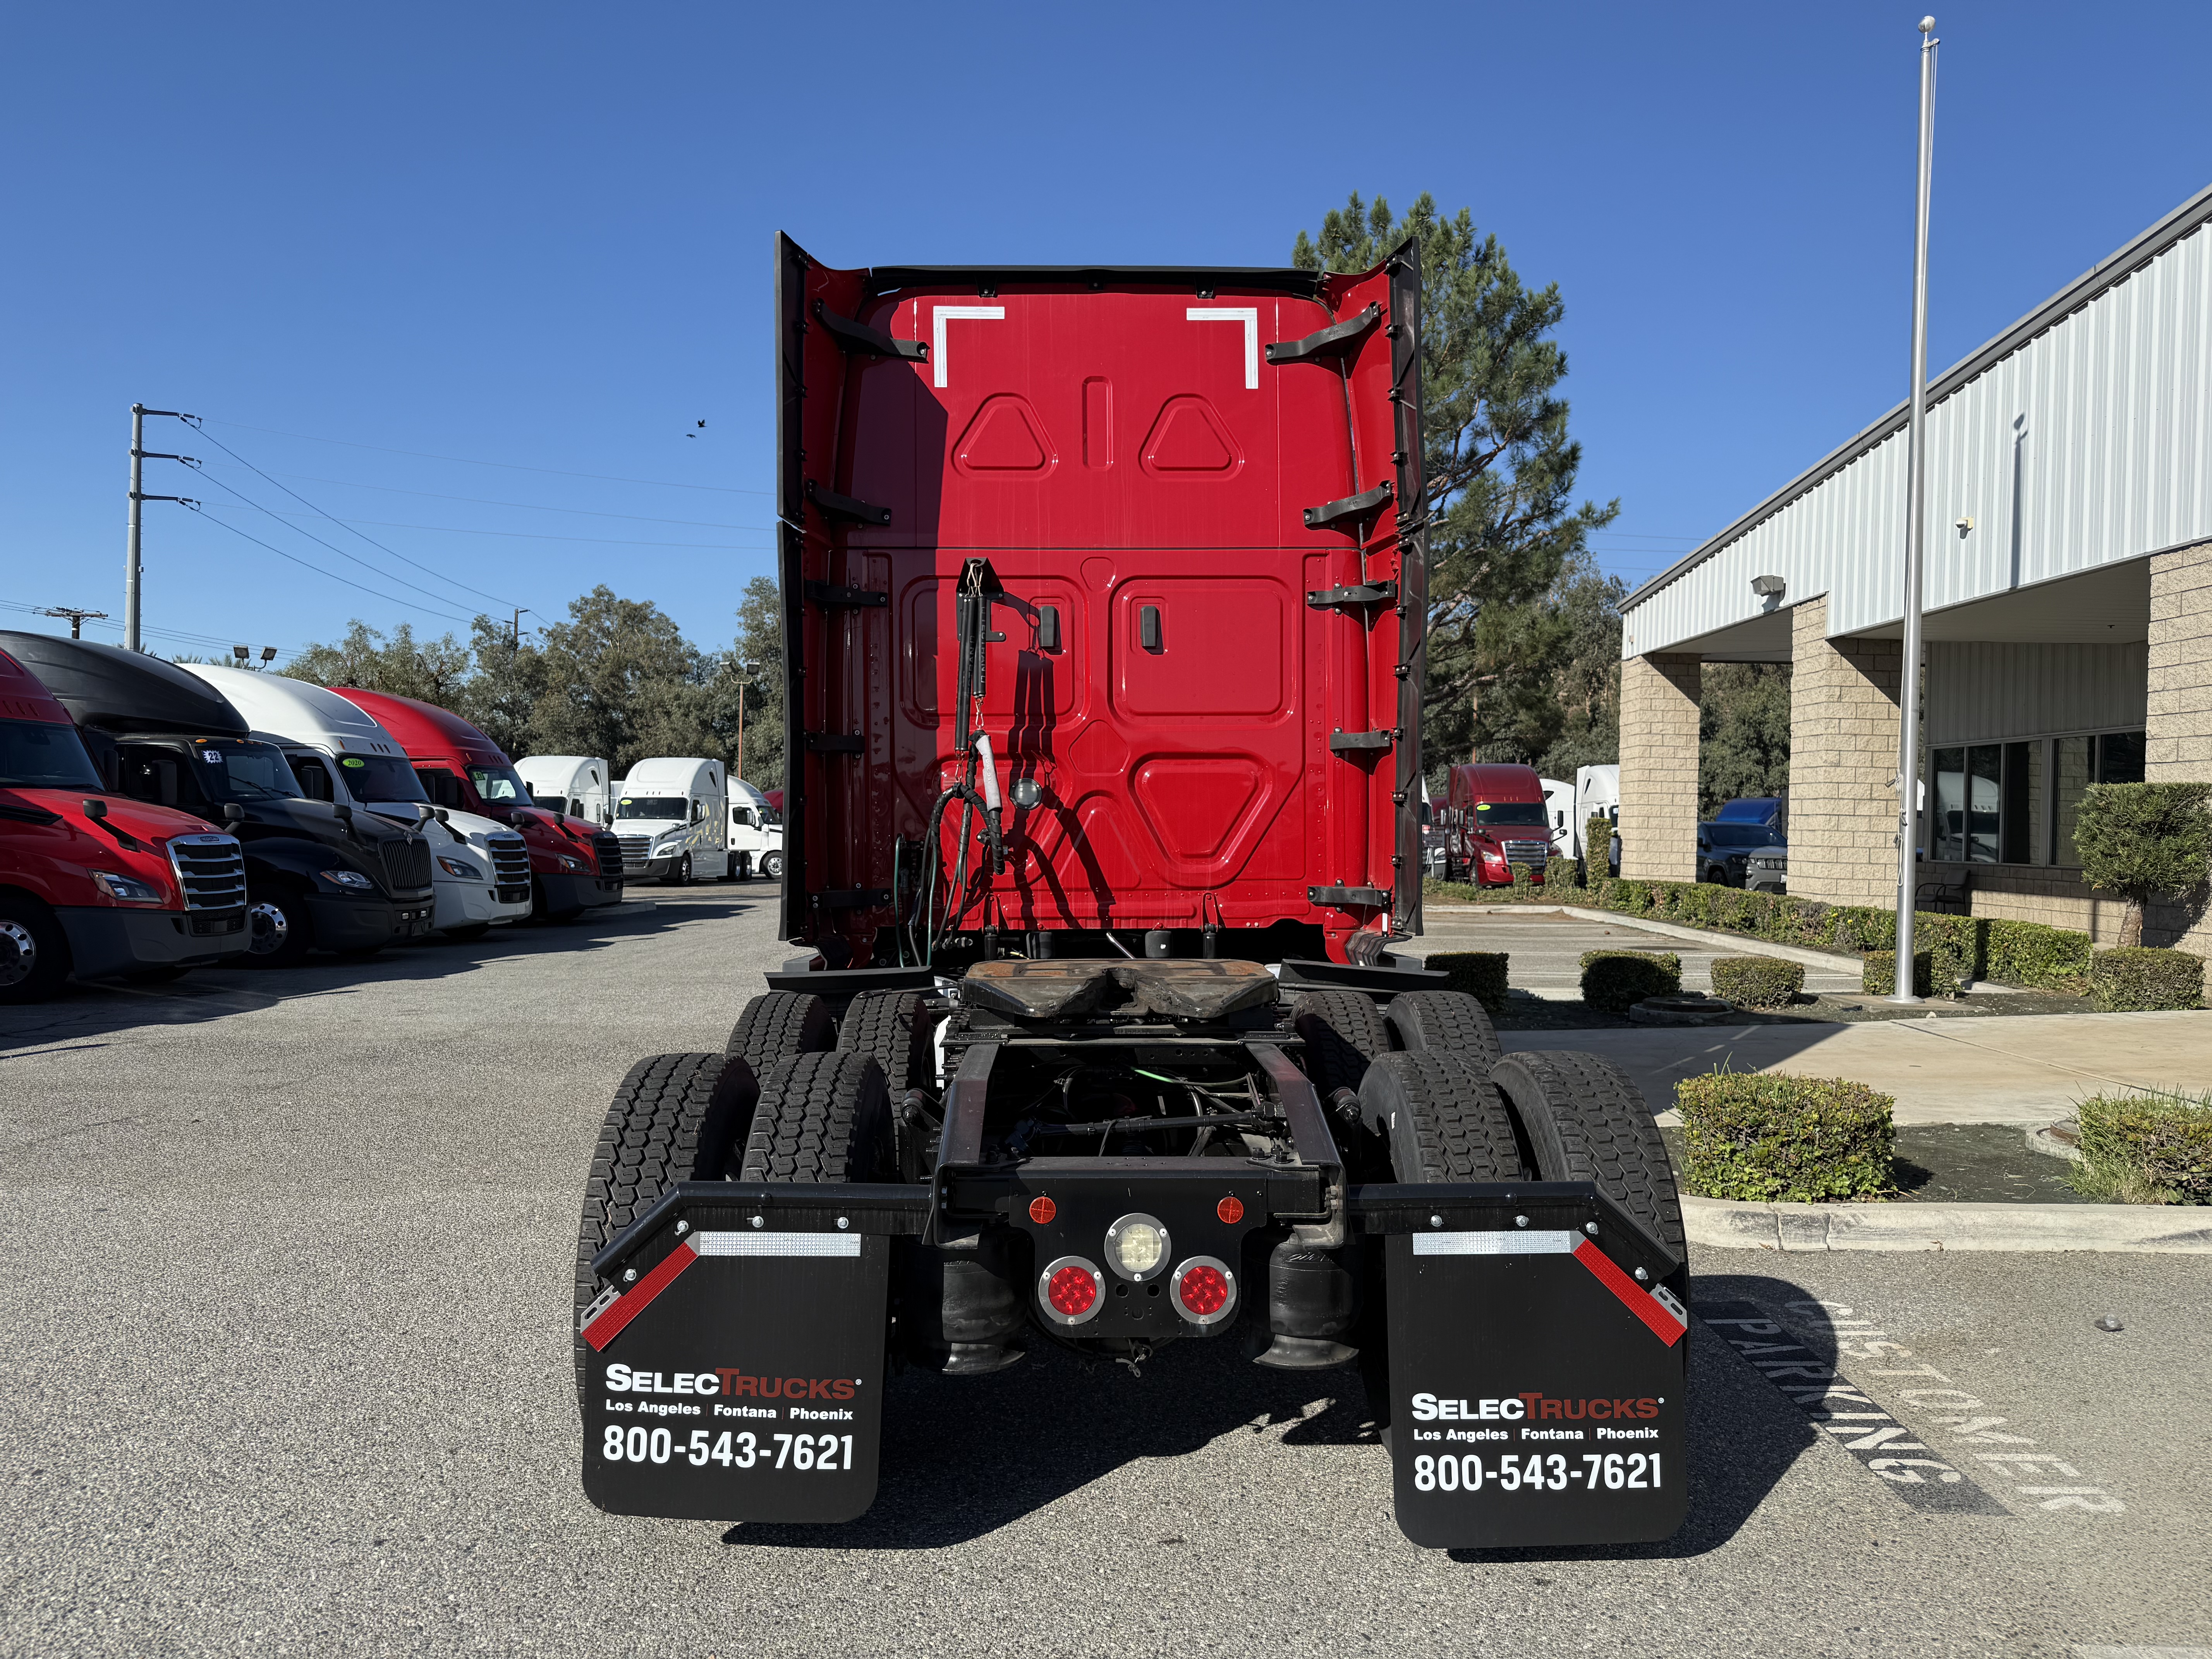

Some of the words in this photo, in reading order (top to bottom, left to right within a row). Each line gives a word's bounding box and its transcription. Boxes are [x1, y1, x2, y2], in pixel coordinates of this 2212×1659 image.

[208, 752, 219, 761] 22
[606, 1399, 633, 1412] Los
[637, 1401, 701, 1416] Angeles
[714, 1405, 776, 1418] Fontana
[790, 1408, 853, 1420] Phoenix
[1704, 1318, 1962, 1483] PARKING
[1784, 1300, 2126, 1511] CUSTOMER
[603, 1425, 852, 1470] 800-543-7621
[1414, 1429, 1441, 1440] Los
[1446, 1429, 1508, 1443] Angeles
[1522, 1429, 1584, 1440] Fontana
[1597, 1427, 1659, 1439] Phoenix
[1415, 1453, 1661, 1491] 800-543-7621
